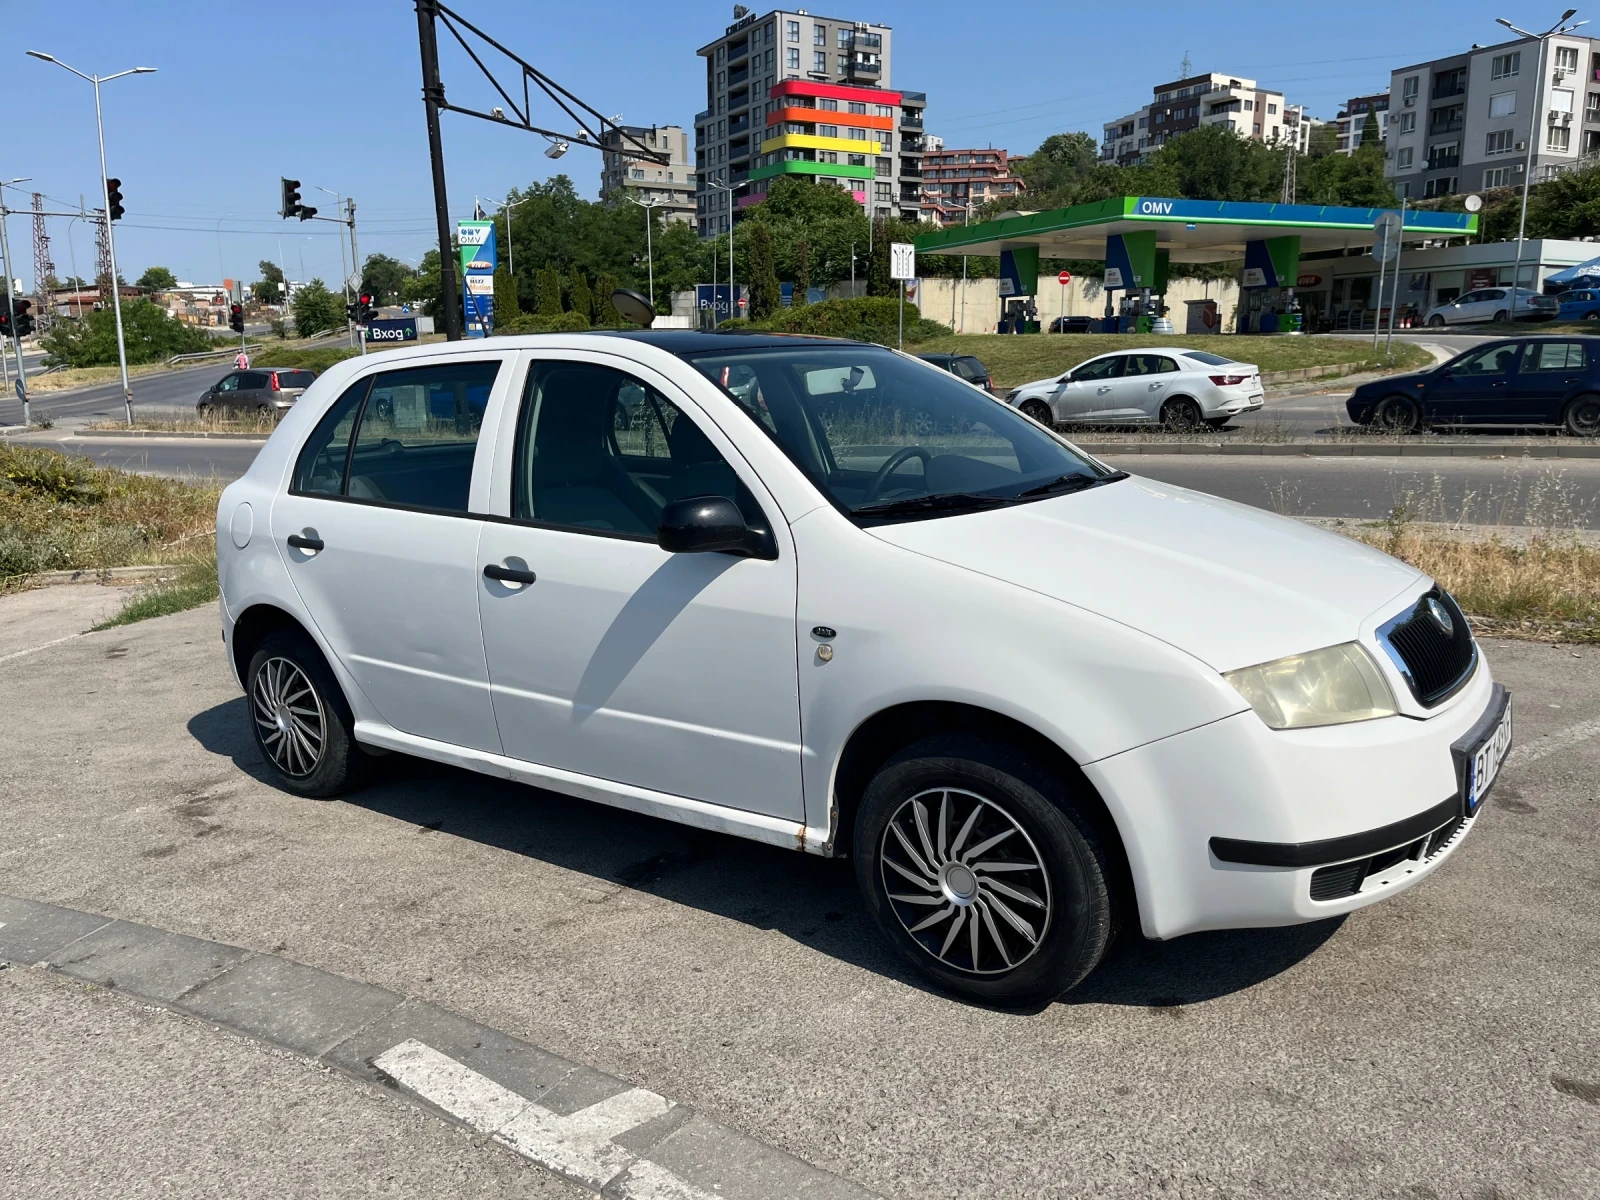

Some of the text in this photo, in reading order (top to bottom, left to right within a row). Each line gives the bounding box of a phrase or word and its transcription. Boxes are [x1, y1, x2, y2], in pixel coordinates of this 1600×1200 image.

[1142, 202, 1173, 214] OMV
[461, 236, 481, 244] OMV
[1298, 276, 1316, 285] VIVA
